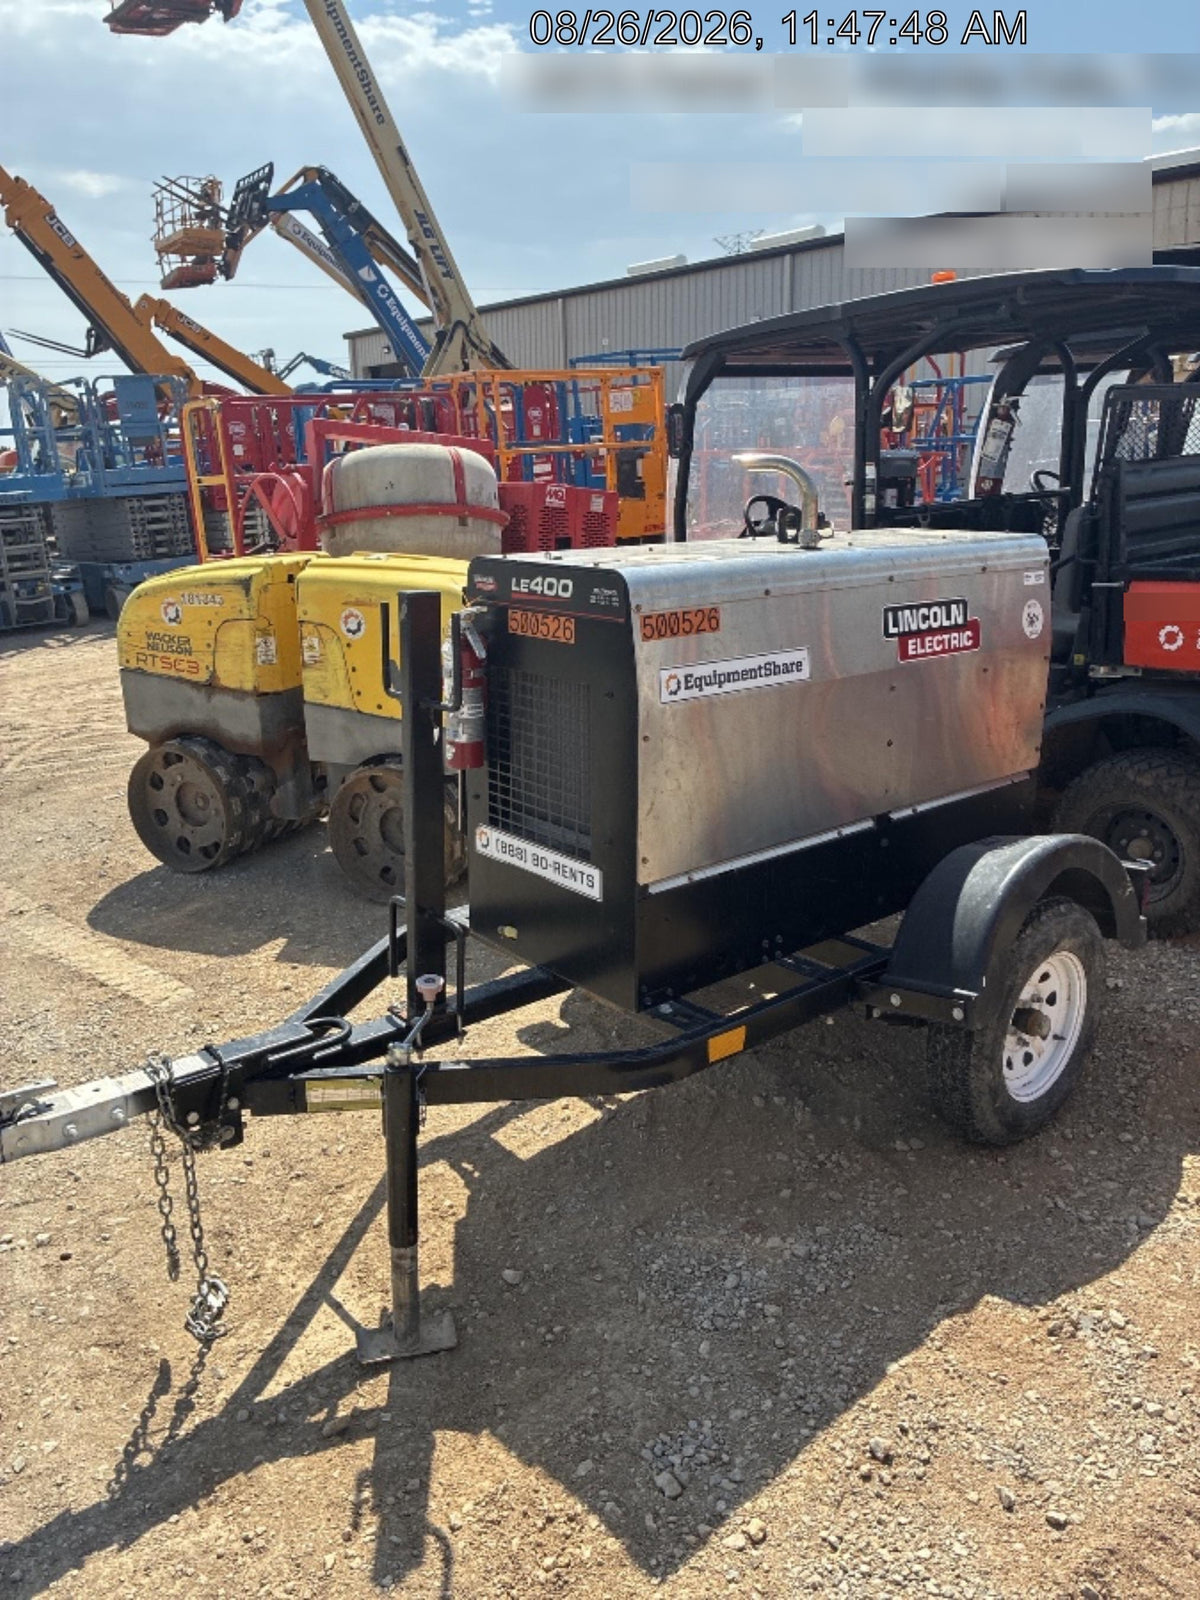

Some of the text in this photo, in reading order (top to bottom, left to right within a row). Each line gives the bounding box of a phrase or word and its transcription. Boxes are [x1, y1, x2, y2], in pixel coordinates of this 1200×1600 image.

[45, 213, 76, 248] JCB
[430, 245, 455, 279] LIFT
[511, 575, 574, 598] LE400
[510, 609, 574, 642] 500526
[642, 607, 720, 640] 500526
[888, 603, 964, 634] LINCOLN
[145, 631, 191, 646] WACKER
[147, 641, 192, 656] NEUSON
[907, 630, 973, 655] ELECTRIC
[684, 658, 803, 691] EquipmentShare
